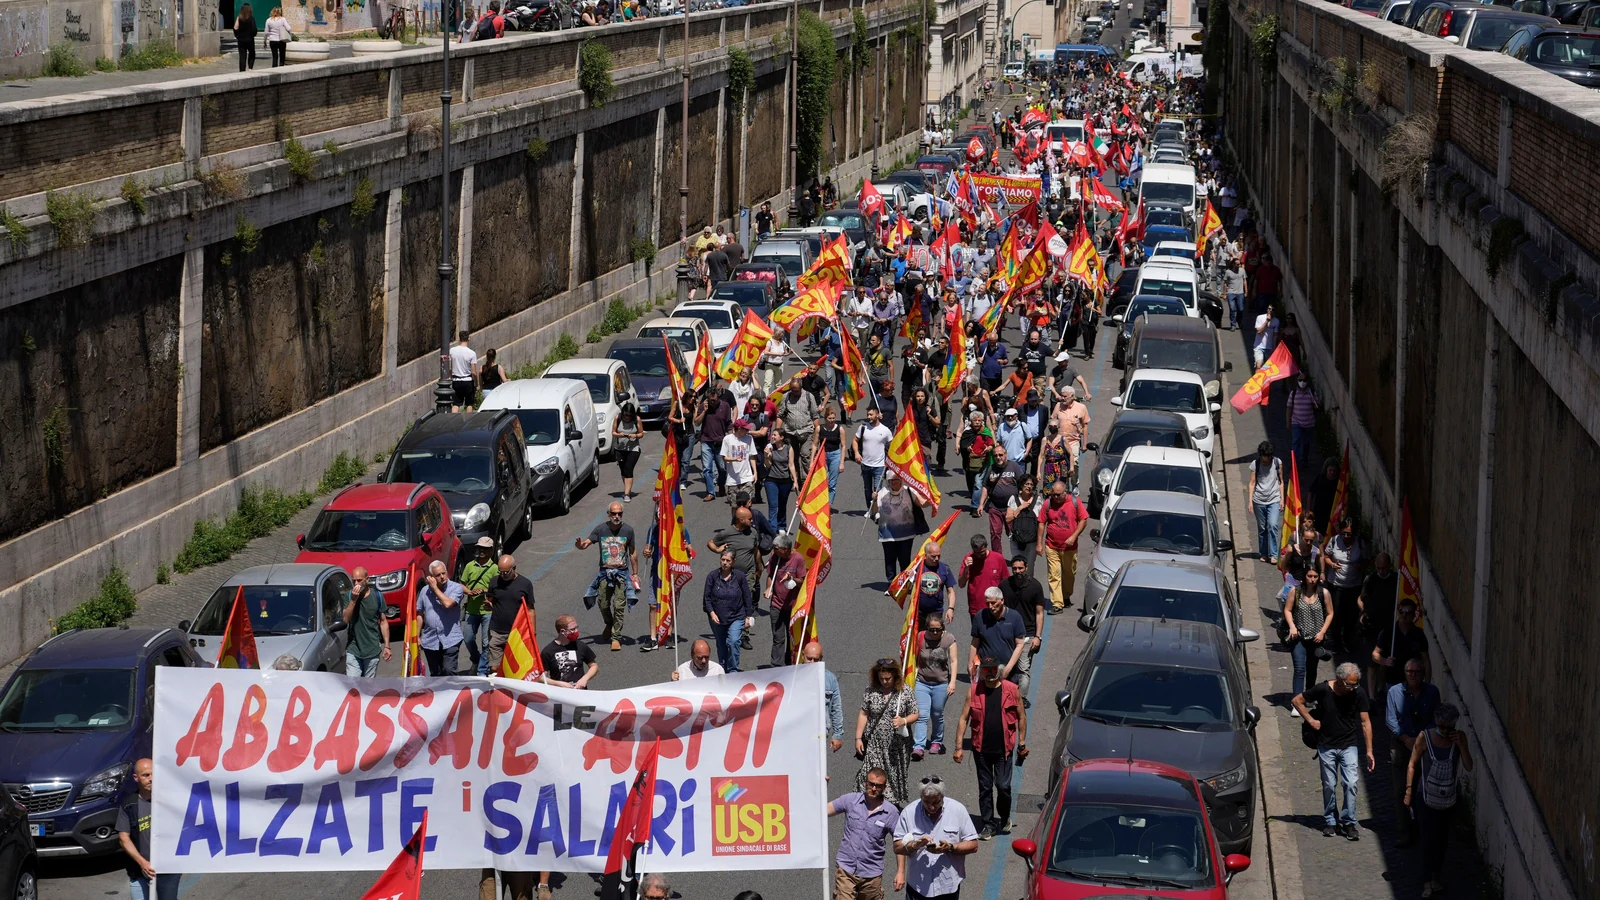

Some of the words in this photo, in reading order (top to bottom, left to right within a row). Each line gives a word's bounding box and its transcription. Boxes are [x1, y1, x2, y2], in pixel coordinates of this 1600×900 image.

[175, 681, 549, 776] ABBASSATE
[553, 703, 597, 731] LE
[582, 680, 785, 774] ARMI
[175, 776, 439, 858] ALZATE
[715, 803, 787, 844] USB
[716, 845, 735, 853] UNIONE
[737, 844, 765, 852] SINDACALE
[767, 844, 772, 852] DI
